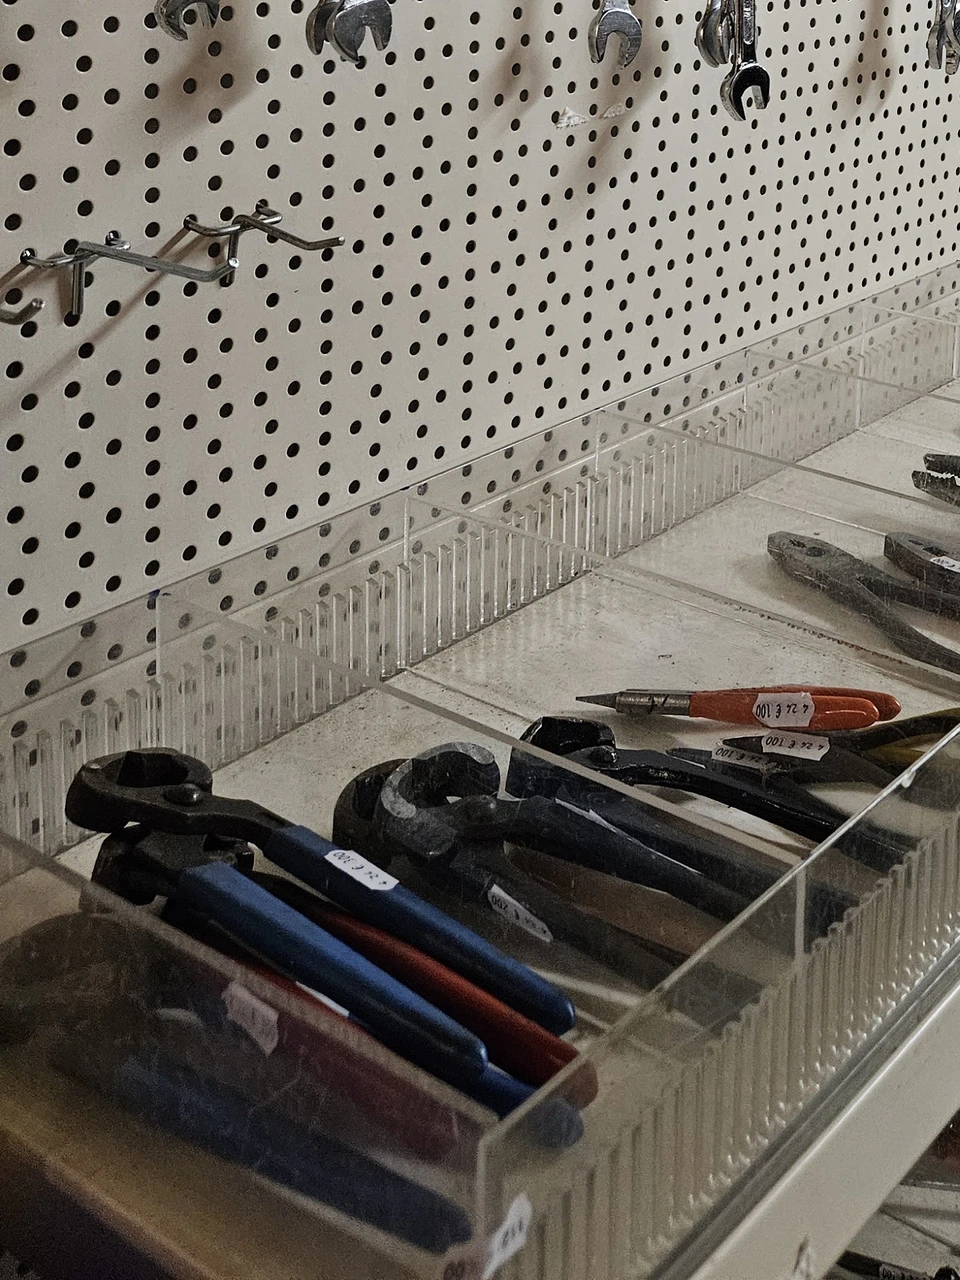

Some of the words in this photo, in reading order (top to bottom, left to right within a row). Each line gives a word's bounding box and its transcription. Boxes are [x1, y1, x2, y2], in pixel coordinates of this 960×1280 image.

[775, 704, 781, 718] €
[786, 704, 797, 713] 24
[802, 704, 809, 713] 4
[788, 740, 796, 749] €
